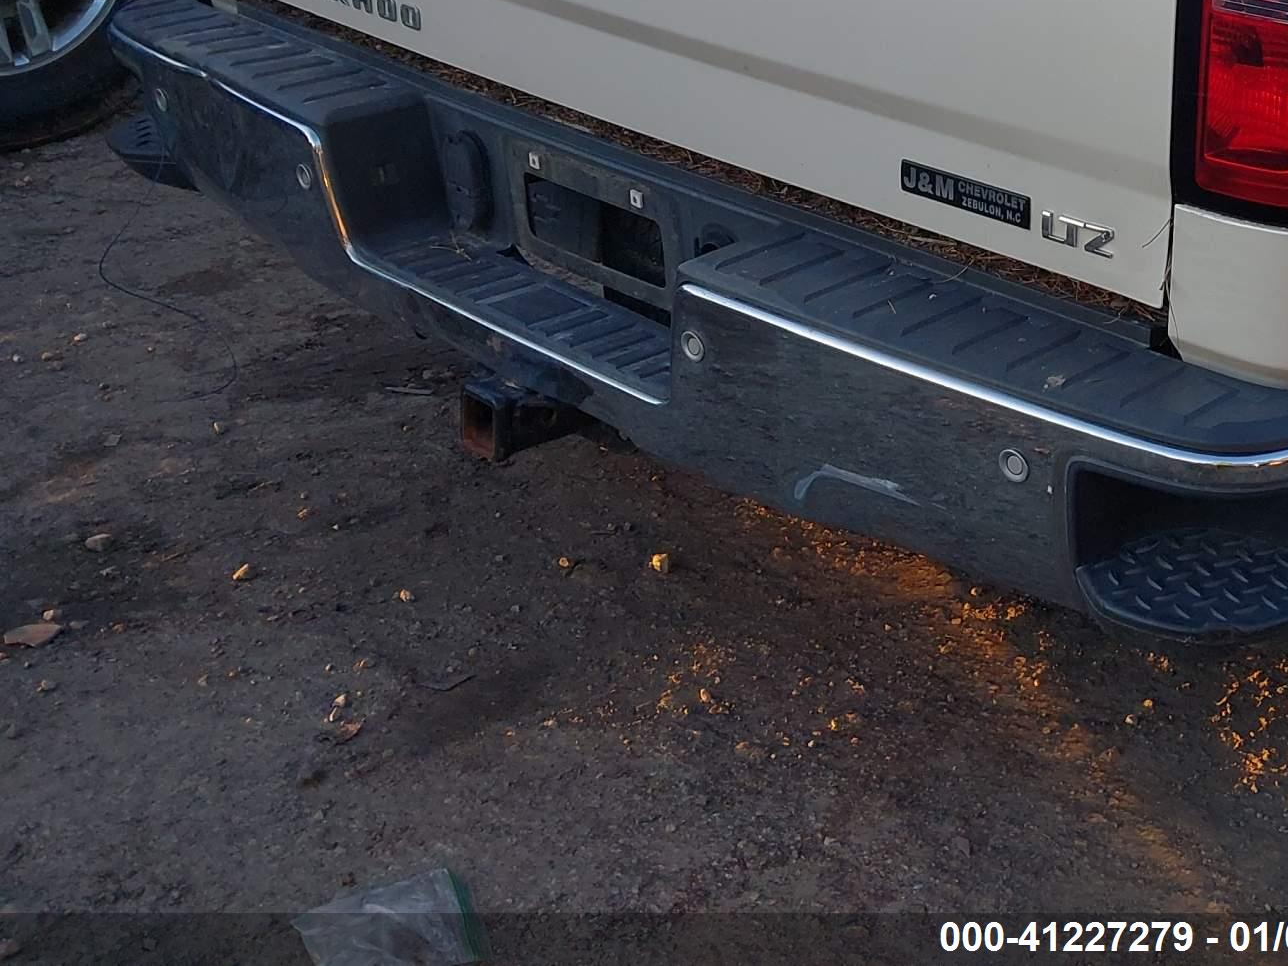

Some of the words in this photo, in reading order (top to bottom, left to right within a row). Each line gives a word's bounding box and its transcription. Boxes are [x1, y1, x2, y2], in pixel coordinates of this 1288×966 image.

[903, 167, 955, 201] J&M
[958, 180, 1027, 212] CHEVROLET
[961, 196, 1005, 220] ZEBULON,
[1041, 209, 1116, 259] LTZ
